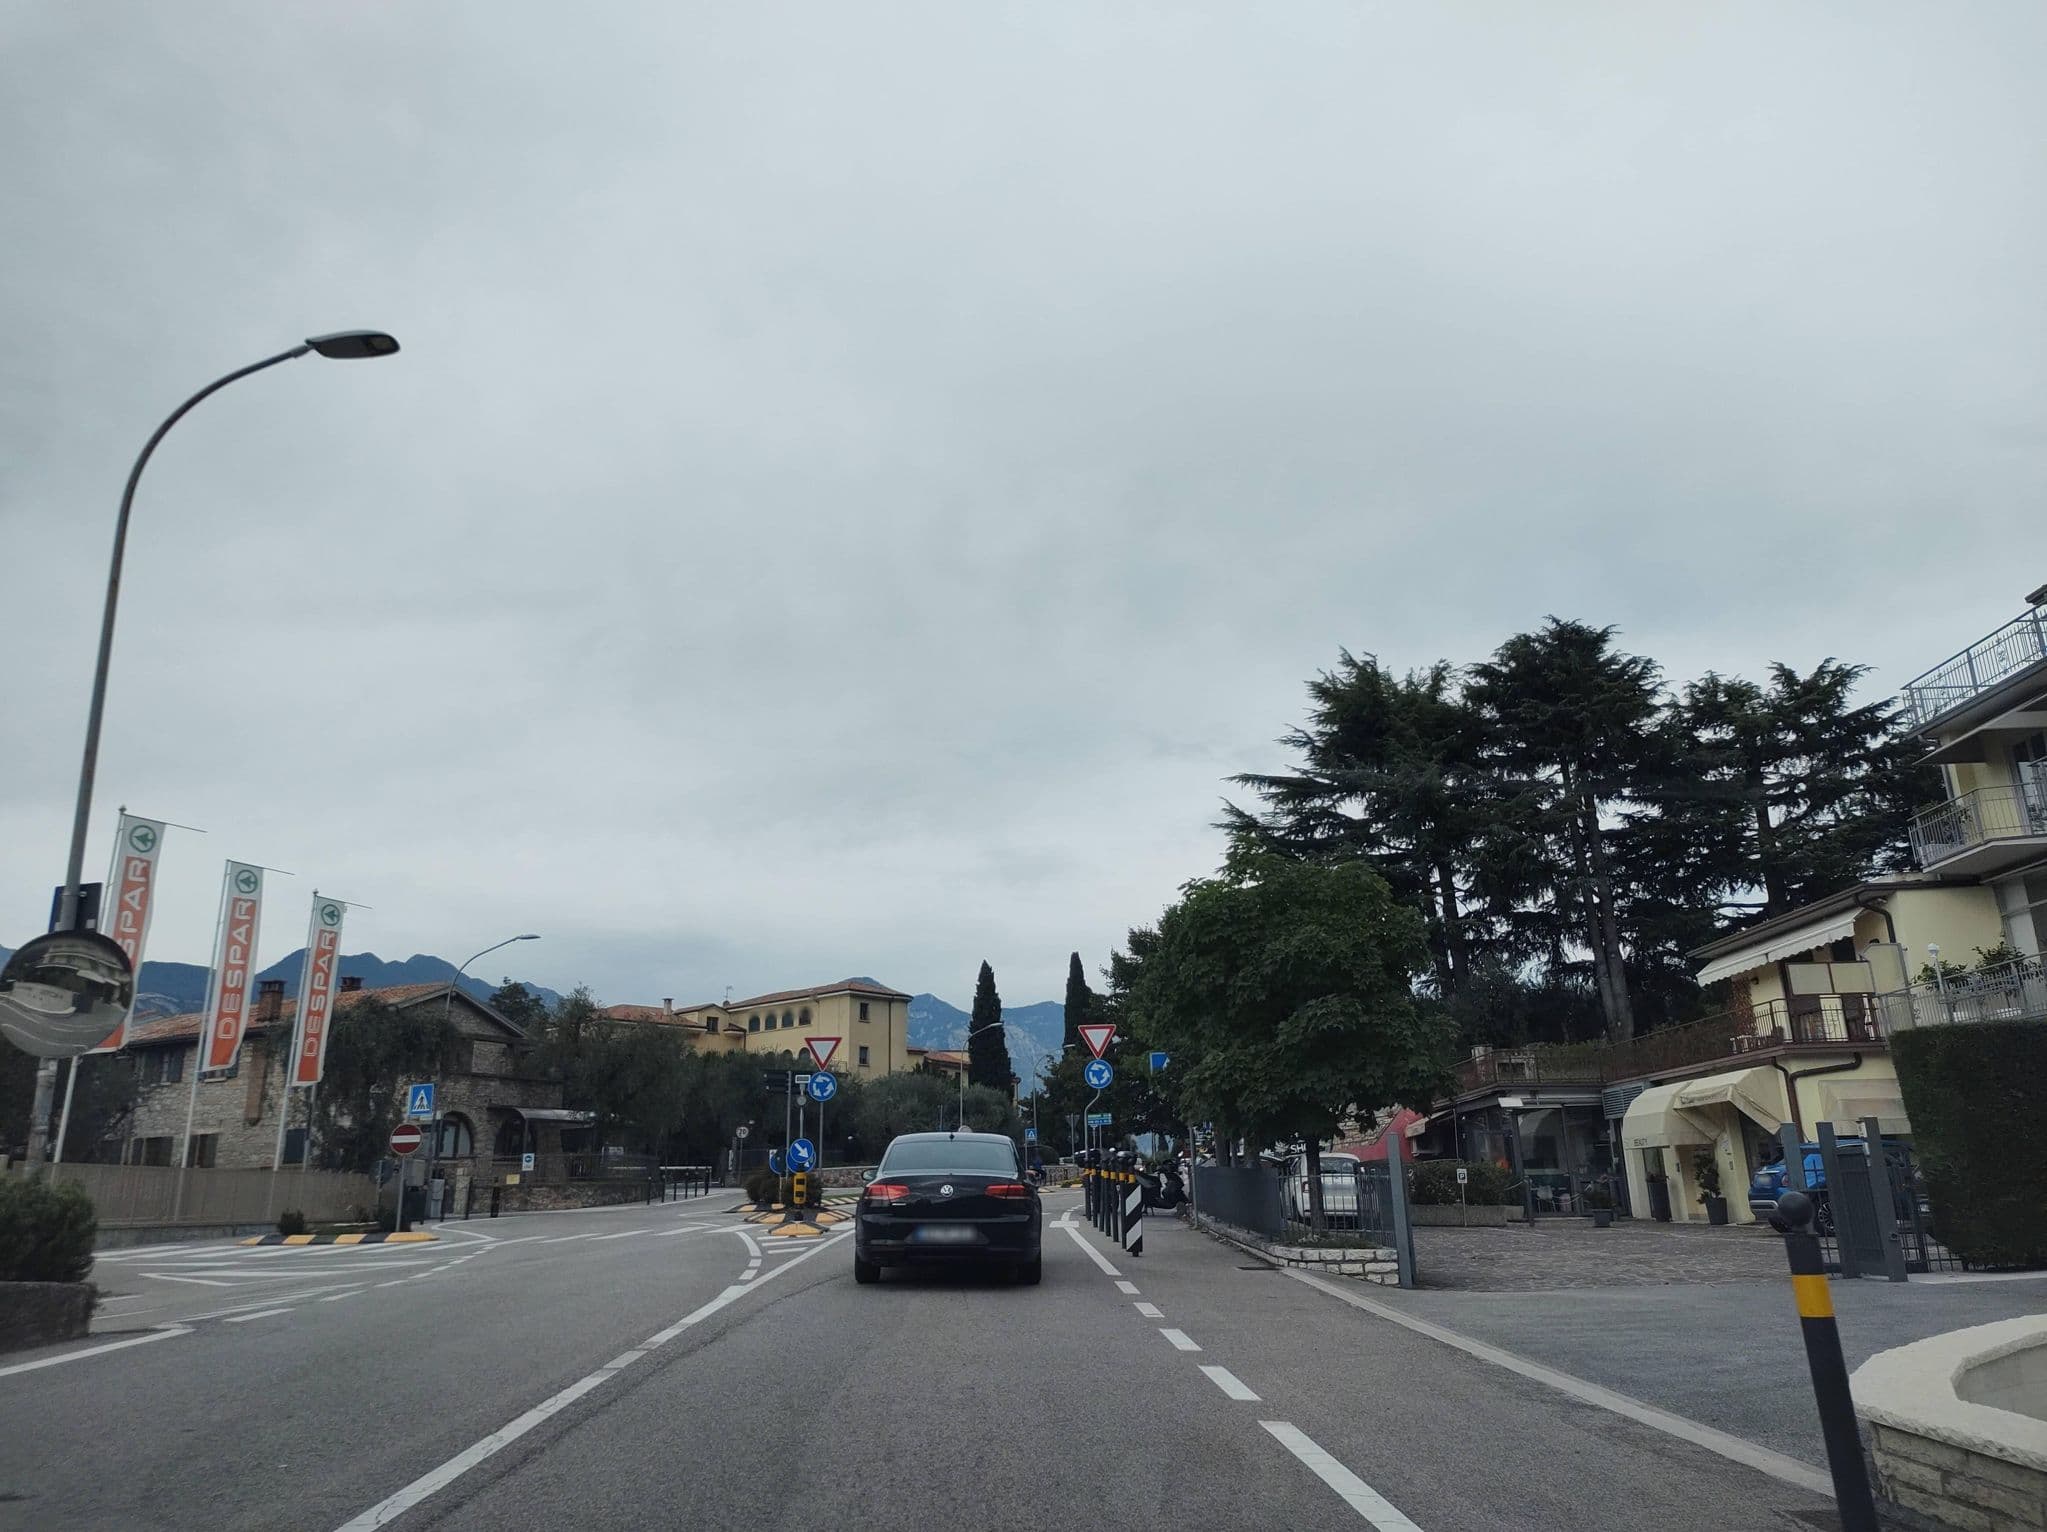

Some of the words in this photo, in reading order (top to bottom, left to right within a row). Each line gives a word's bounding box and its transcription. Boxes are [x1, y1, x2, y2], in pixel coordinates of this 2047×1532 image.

[119, 859, 148, 960] SPAR
[217, 898, 253, 1039] DESPAR
[303, 931, 336, 1057] DESPAR
